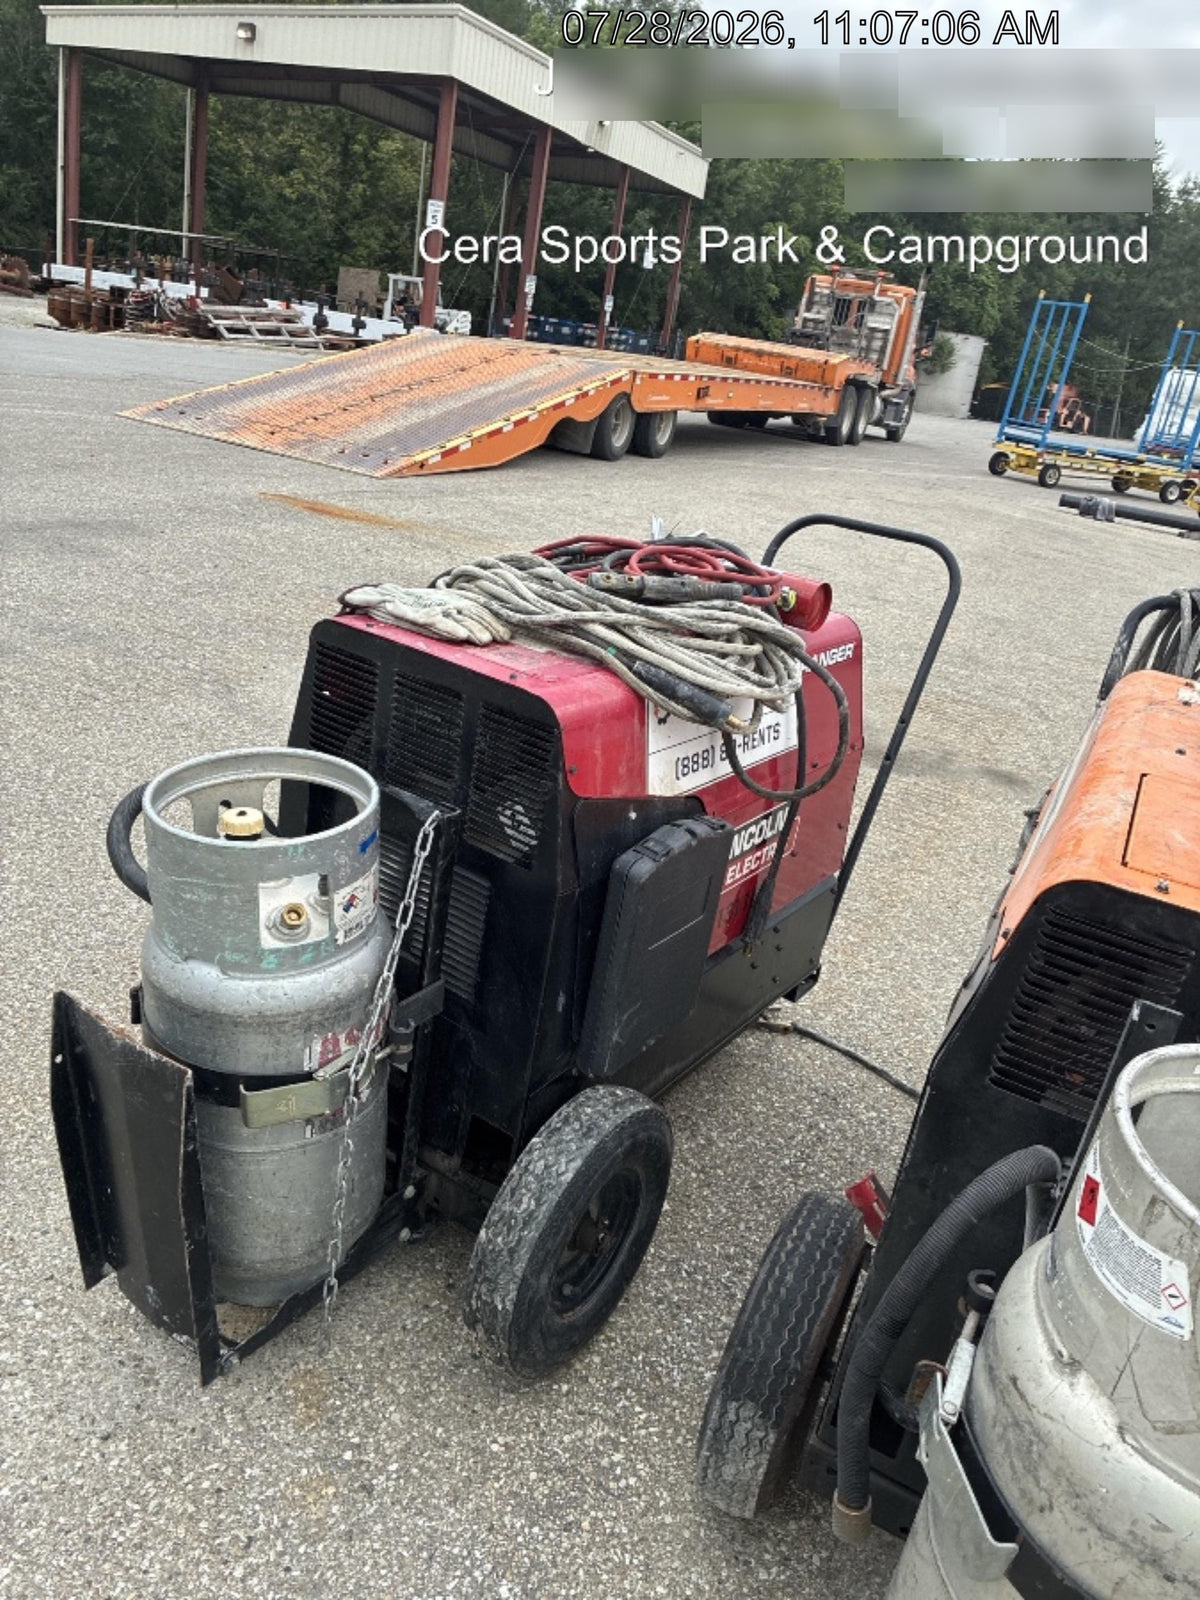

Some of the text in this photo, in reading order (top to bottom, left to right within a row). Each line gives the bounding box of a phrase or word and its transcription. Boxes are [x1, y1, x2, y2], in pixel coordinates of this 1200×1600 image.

[675, 722, 781, 781] (888) 8-RENTS
[728, 806, 790, 860] NCOLN
[724, 842, 778, 886] ELECTR
